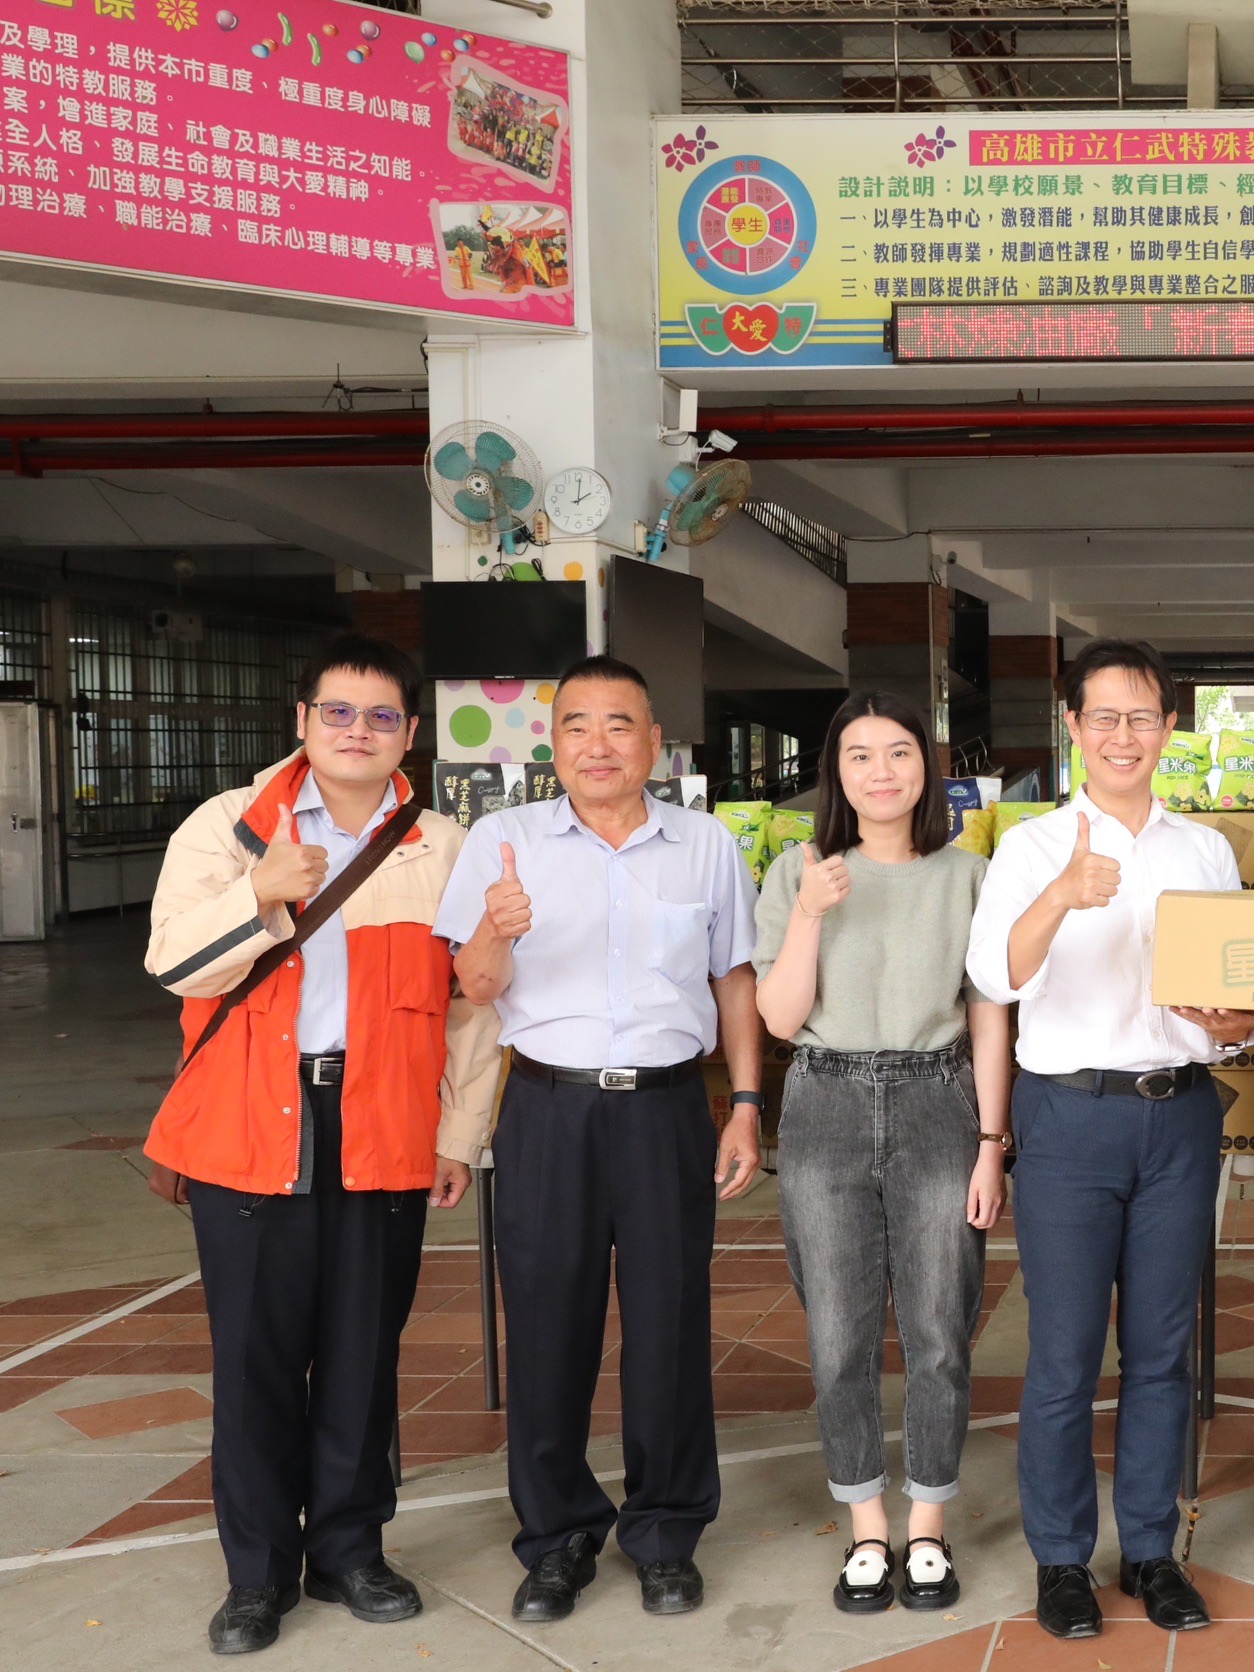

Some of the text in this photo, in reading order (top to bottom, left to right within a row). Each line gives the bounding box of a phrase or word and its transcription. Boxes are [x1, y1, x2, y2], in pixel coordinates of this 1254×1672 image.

[0, 118, 383, 202] 全人格、發展生命教育與大愛精神。
[0, 150, 296, 218] 系統、加強教學支援服務。
[0, 183, 435, 269] 理治療、職能治療、臨床心理輔導等專業
[732, 217, 763, 232] 學生
[700, 317, 719, 336] 仁
[731, 311, 768, 342] 大愛
[1158, 757, 1197, 775] 星米果
[545, 776, 557, 801] 黑芝
